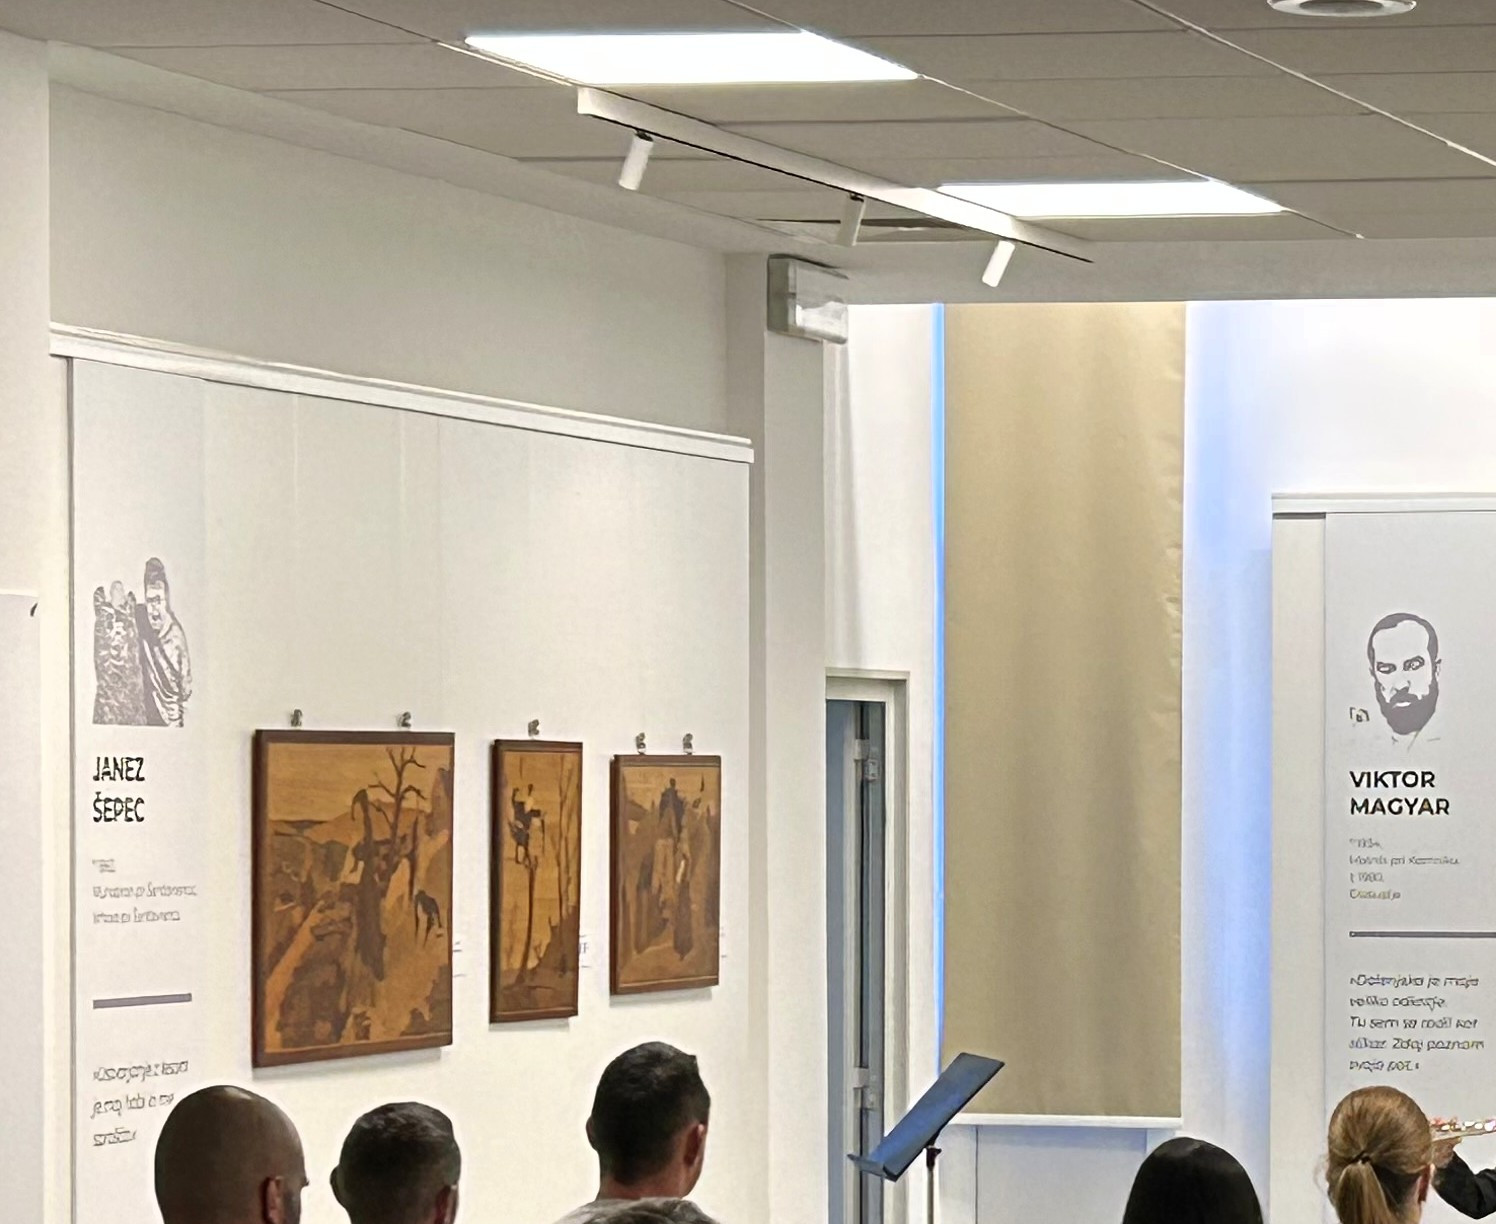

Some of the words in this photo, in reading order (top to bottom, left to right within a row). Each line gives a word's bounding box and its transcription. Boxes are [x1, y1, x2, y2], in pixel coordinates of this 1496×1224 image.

[93, 756, 145, 781] JANEZ
[1350, 770, 1435, 788] VIKTOR
[93, 791, 145, 822] ŠEPEC
[1350, 797, 1450, 815] MAGYAR
[1350, 1016, 1366, 1028] Tu
[1370, 1019, 1399, 1029] sem
